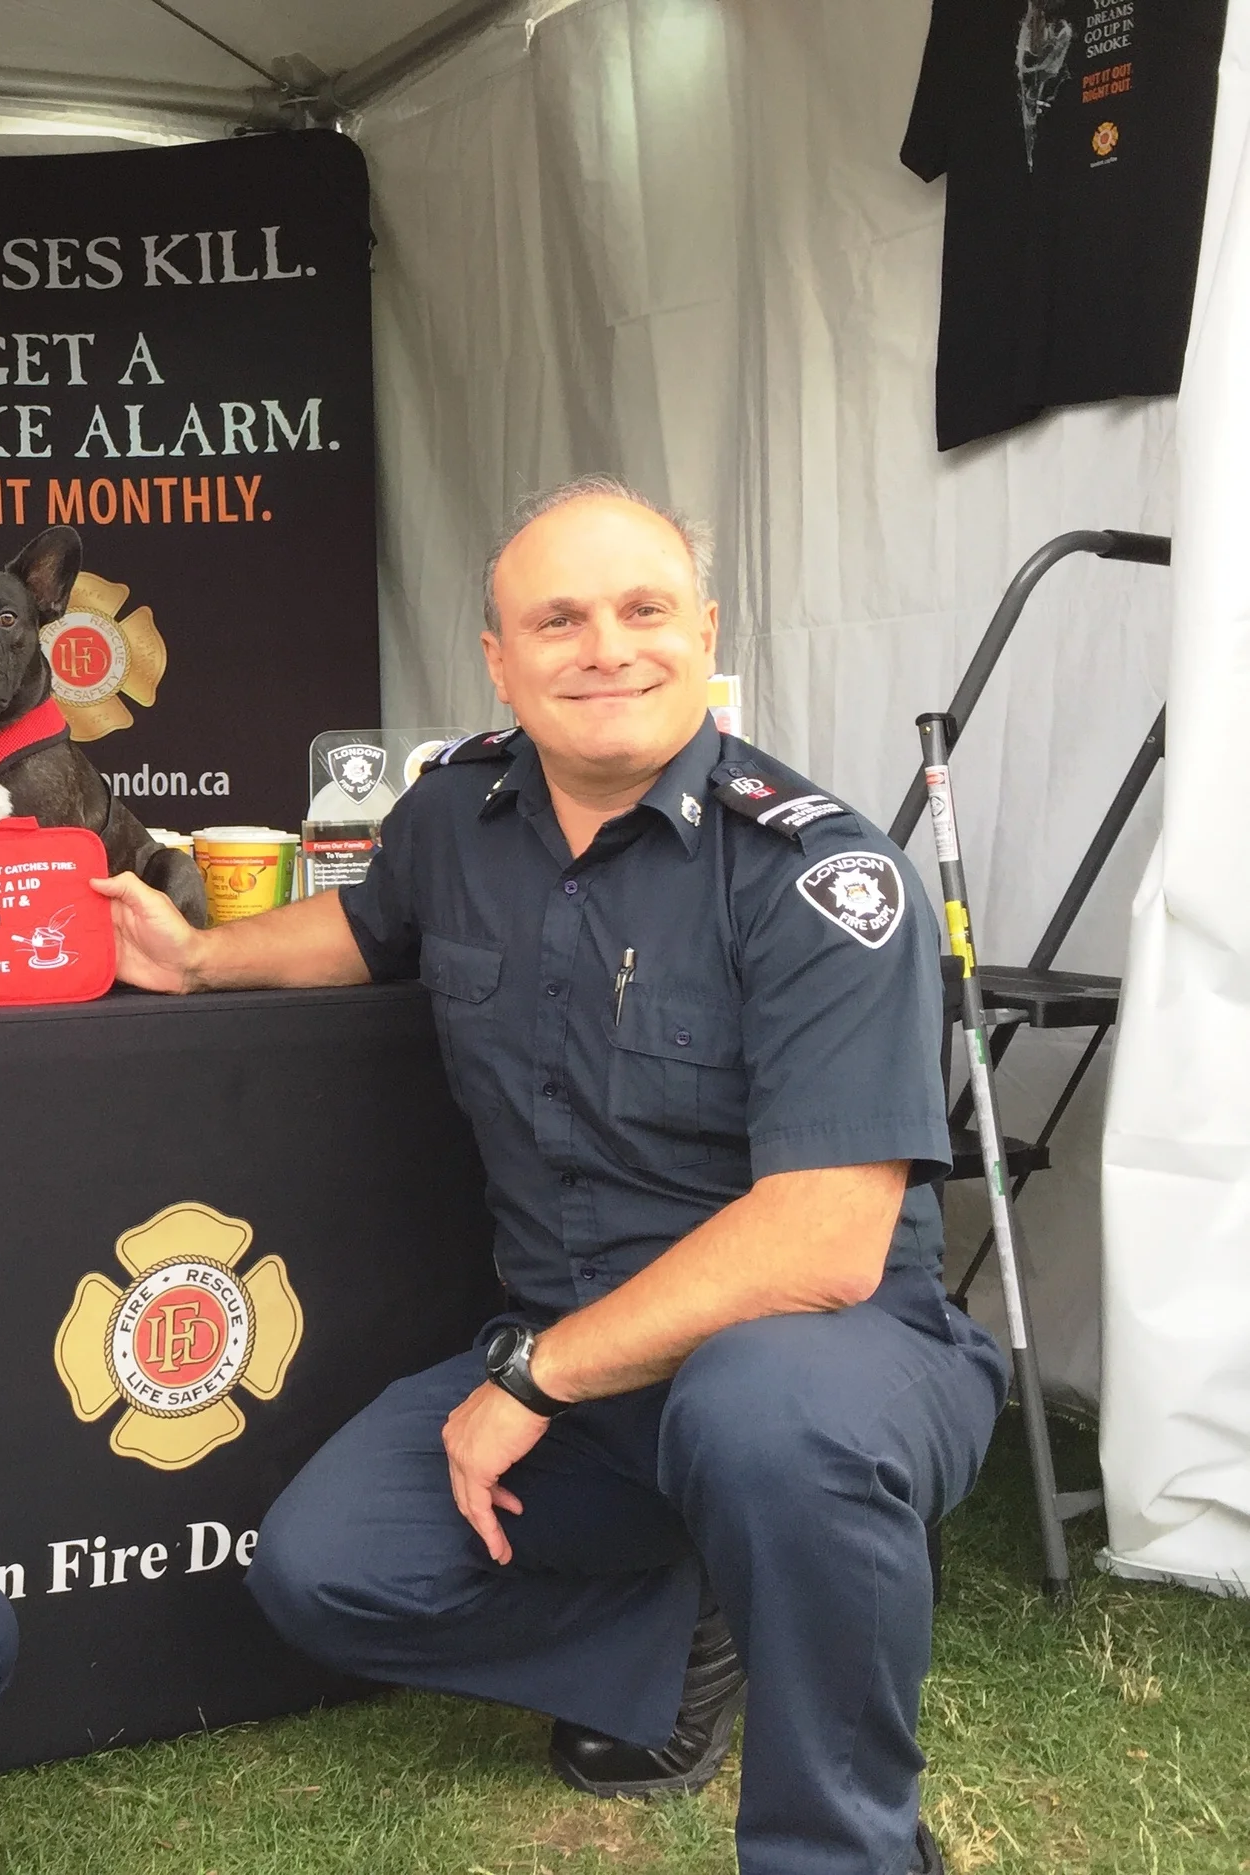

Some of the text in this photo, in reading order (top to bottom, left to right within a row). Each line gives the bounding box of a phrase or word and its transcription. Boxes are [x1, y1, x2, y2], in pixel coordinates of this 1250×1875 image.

[1086, 2, 1134, 28] DREAMS
[1084, 28, 1102, 44] GO
[1104, 22, 1120, 37] UP
[1082, 72, 1101, 88] PUT
[1102, 68, 1110, 83] IT
[1082, 83, 1110, 103] RIGHT
[144, 226, 317, 287] KILL.
[117, 331, 165, 386] A
[76, 398, 341, 459] ALARM.
[48, 475, 273, 525] MONTHLY.
[42, 618, 69, 645] FIRE
[90, 616, 125, 666] RESCUE
[53, 674, 120, 700] IFE SAFETY
[333, 747, 381, 760] LONDON
[100, 763, 230, 796] ndon.ca
[339, 778, 355, 793] FIRE
[343, 842, 366, 850] Family
[5, 862, 49, 875] CATCHES
[51, 861, 76, 871] FIRE:
[806, 858, 885, 887] LONDON
[5, 881, 14, 892] A
[17, 878, 41, 891] LID
[2, 896, 16, 909] IT
[18, 895, 30, 907] &
[838, 912, 868, 931] FIRE
[119, 1268, 244, 1334] FIRE RESCUE
[125, 1355, 236, 1406] LIFE SAFETY
[46, 1535, 169, 1595] Fire
